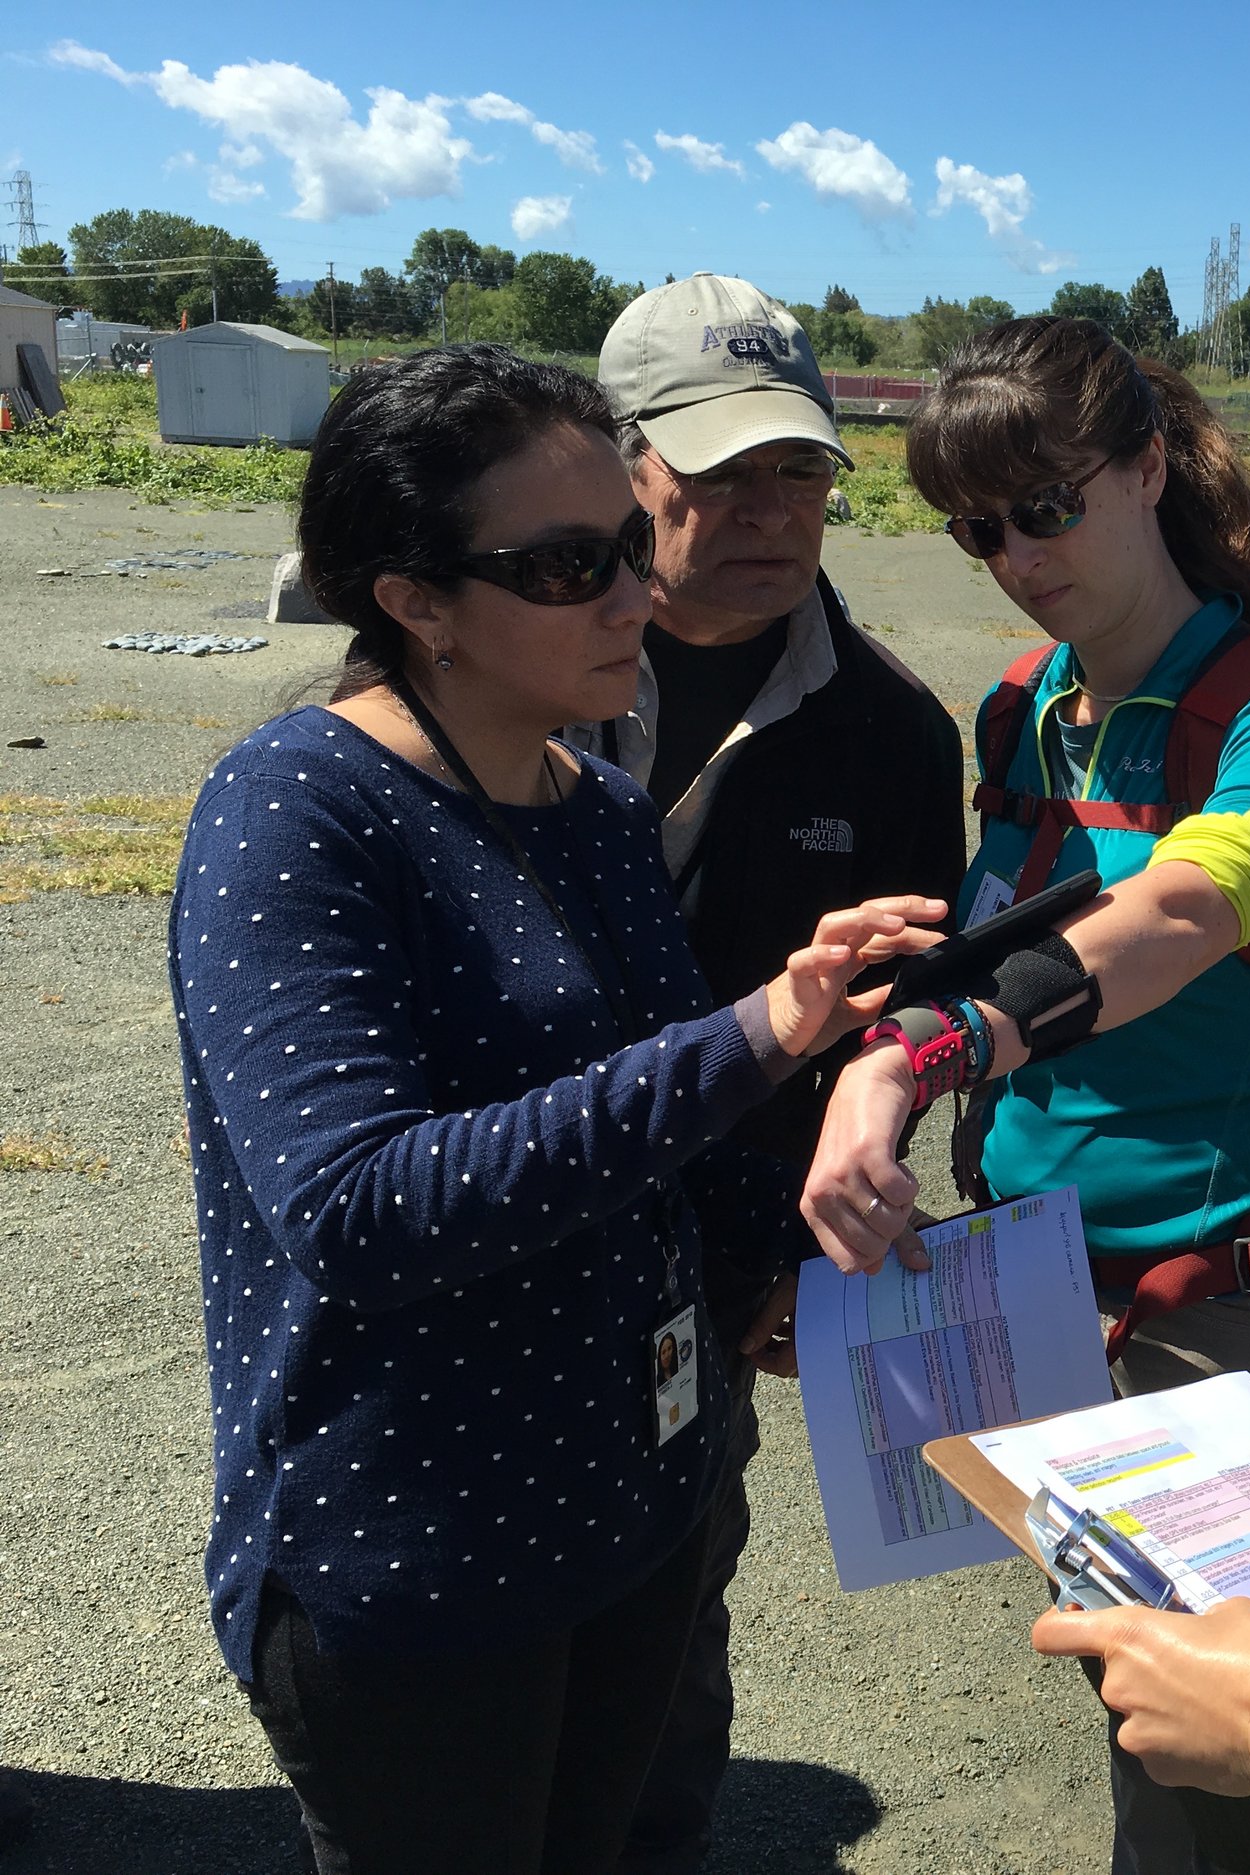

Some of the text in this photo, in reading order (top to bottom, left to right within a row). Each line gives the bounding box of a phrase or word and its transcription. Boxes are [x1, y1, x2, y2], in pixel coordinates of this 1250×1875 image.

[736, 339, 760, 352] 94
[811, 817, 838, 830] THE
[789, 828, 836, 840] NORTH
[802, 840, 835, 851] FACE
